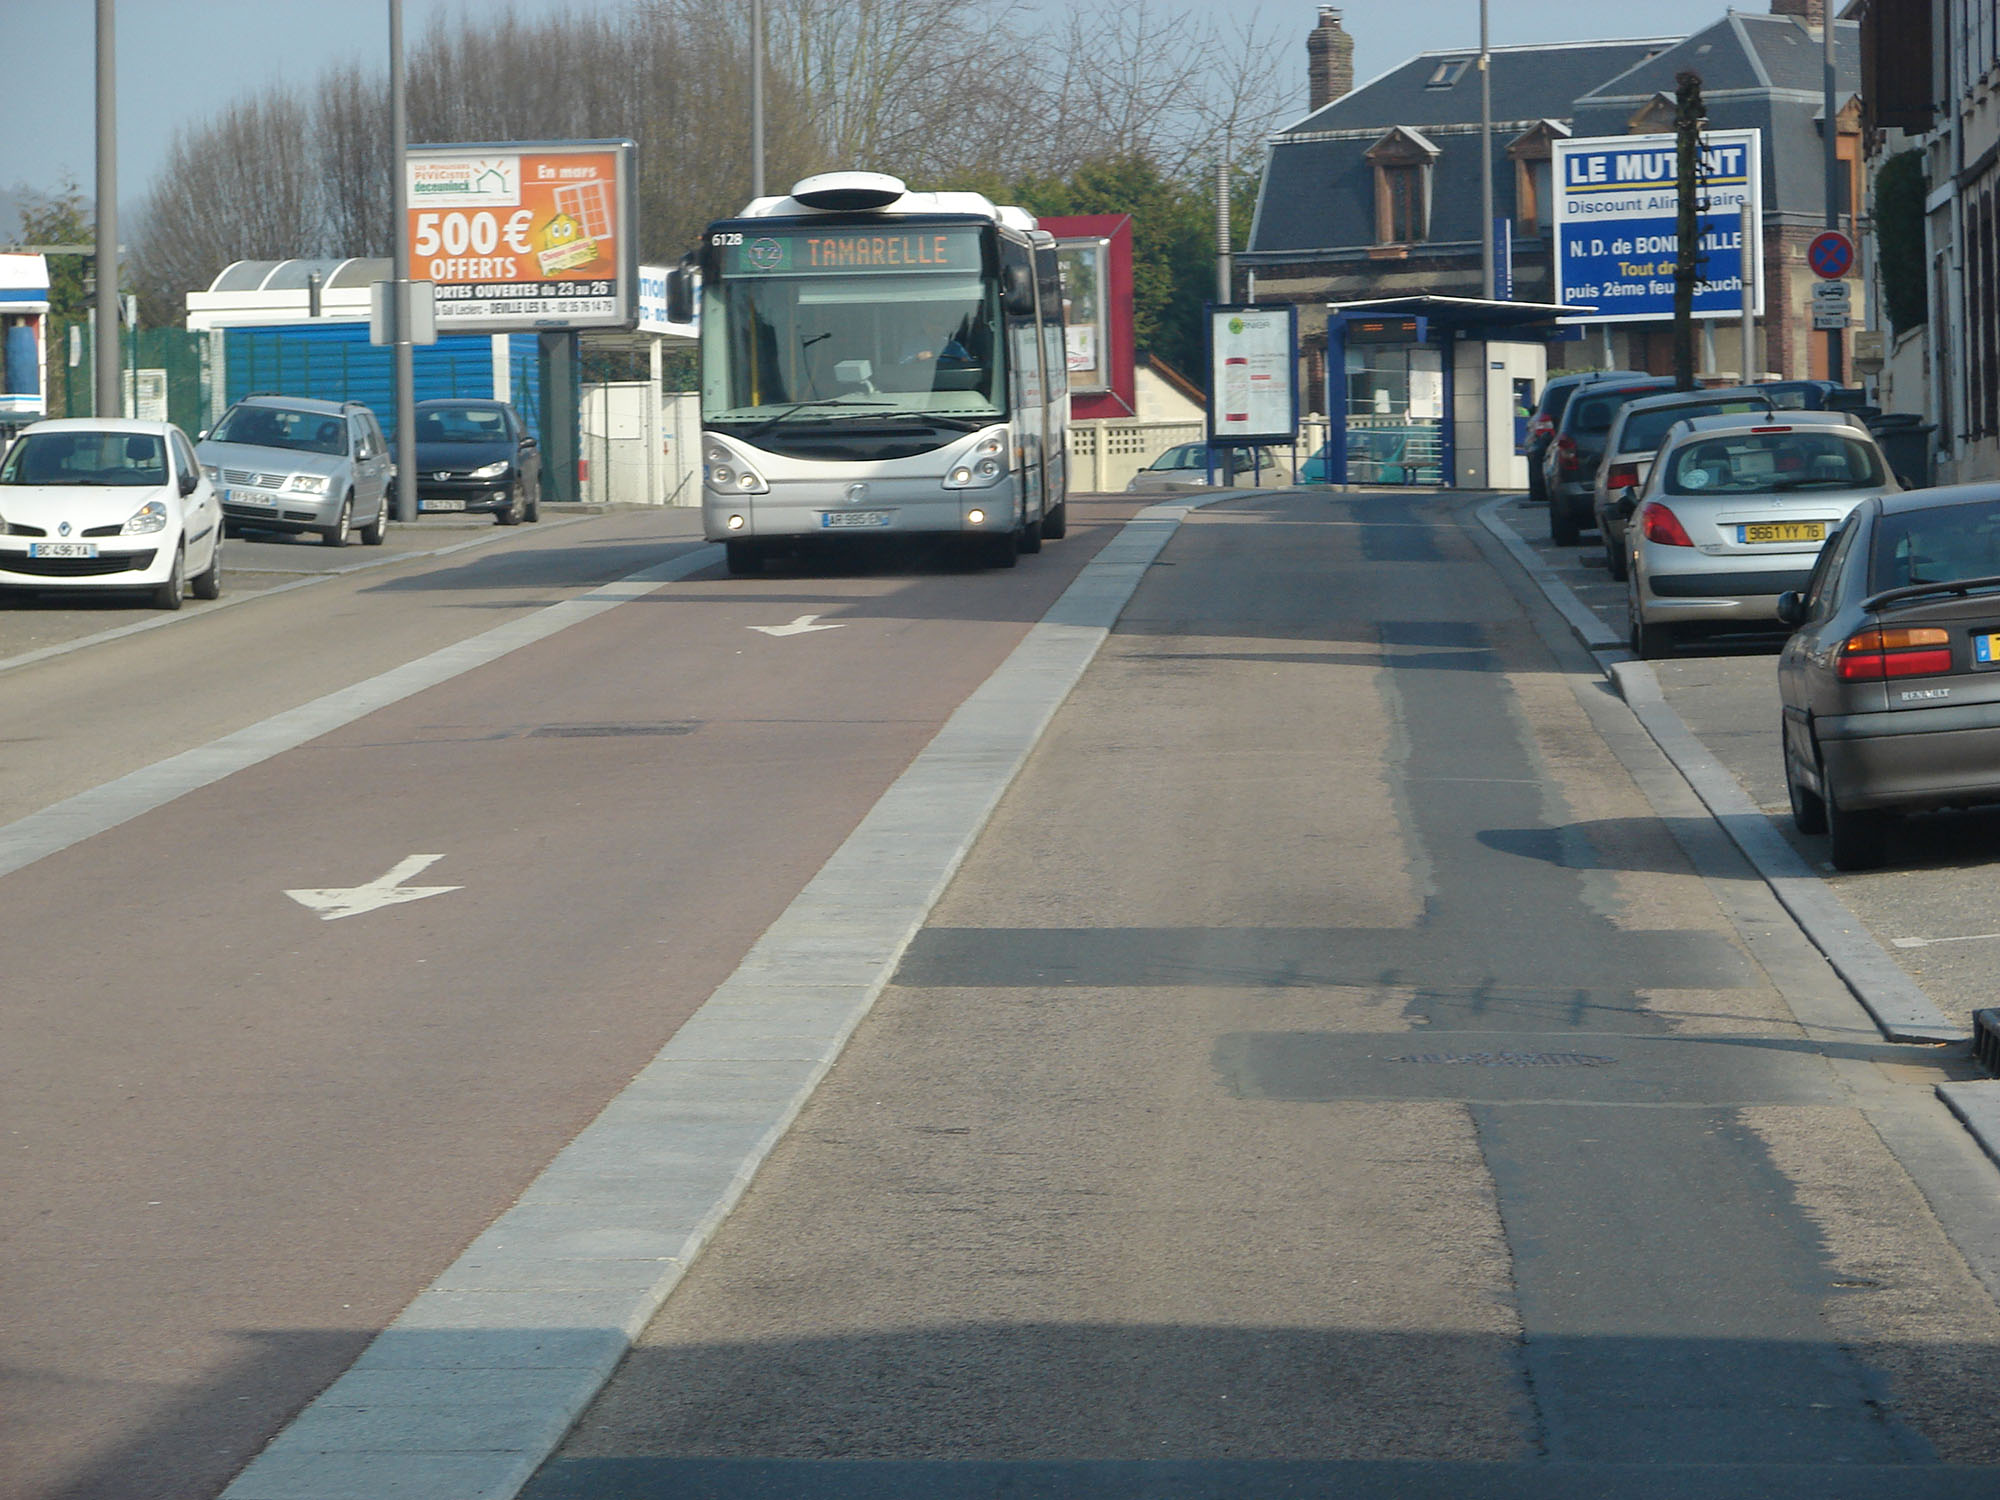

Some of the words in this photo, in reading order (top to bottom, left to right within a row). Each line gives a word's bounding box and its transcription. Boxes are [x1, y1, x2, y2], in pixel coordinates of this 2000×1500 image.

[537, 164, 556, 179] En
[559, 166, 598, 179] mars
[1570, 156, 1608, 184] LE
[1615, 148, 1743, 181] MUTNT
[1567, 198, 1642, 215] Discount
[414, 211, 499, 256] 500
[502, 209, 534, 254] €
[711, 233, 743, 246] 6128
[807, 236, 948, 266] TAMARELLE
[1570, 241, 1588, 257] N.
[1591, 239, 1609, 256] D.
[1611, 238, 1633, 255] de
[429, 257, 517, 280] OFFERTS
[1618, 262, 1655, 277] Tout
[475, 284, 539, 298] OUVERTES
[541, 284, 556, 296] du
[557, 283, 575, 295] 23
[575, 284, 590, 295] au
[591, 281, 609, 294] 26
[1565, 285, 1600, 302] puis
[1603, 281, 1646, 297] 2ème
[1650, 280, 1676, 295] feu
[524, 301, 539, 313] LES
[1749, 526, 1780, 539] 9661
[1784, 525, 1800, 538] YY
[1804, 524, 1820, 538] 76
